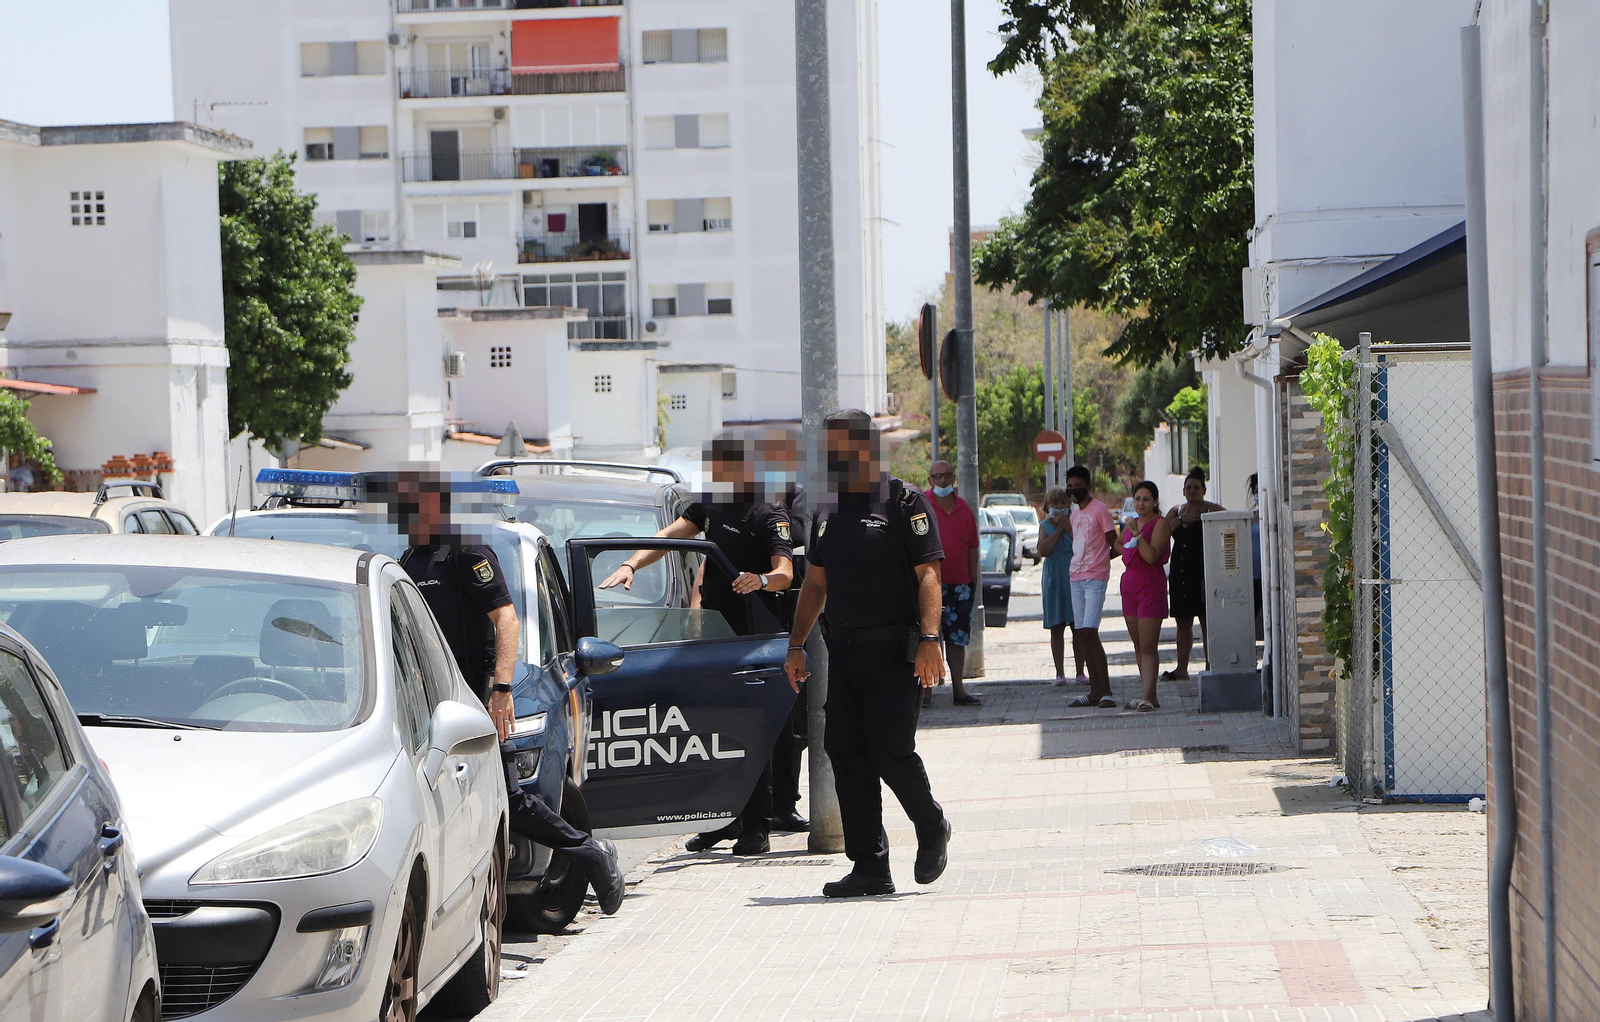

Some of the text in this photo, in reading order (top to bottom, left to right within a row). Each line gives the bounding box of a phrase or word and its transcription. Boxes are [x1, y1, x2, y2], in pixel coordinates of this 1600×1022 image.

[417, 579, 438, 587] POLICIA
[590, 703, 690, 738] ICÍA
[587, 733, 745, 769] IONAL
[656, 811, 732, 821] www.policia.es
